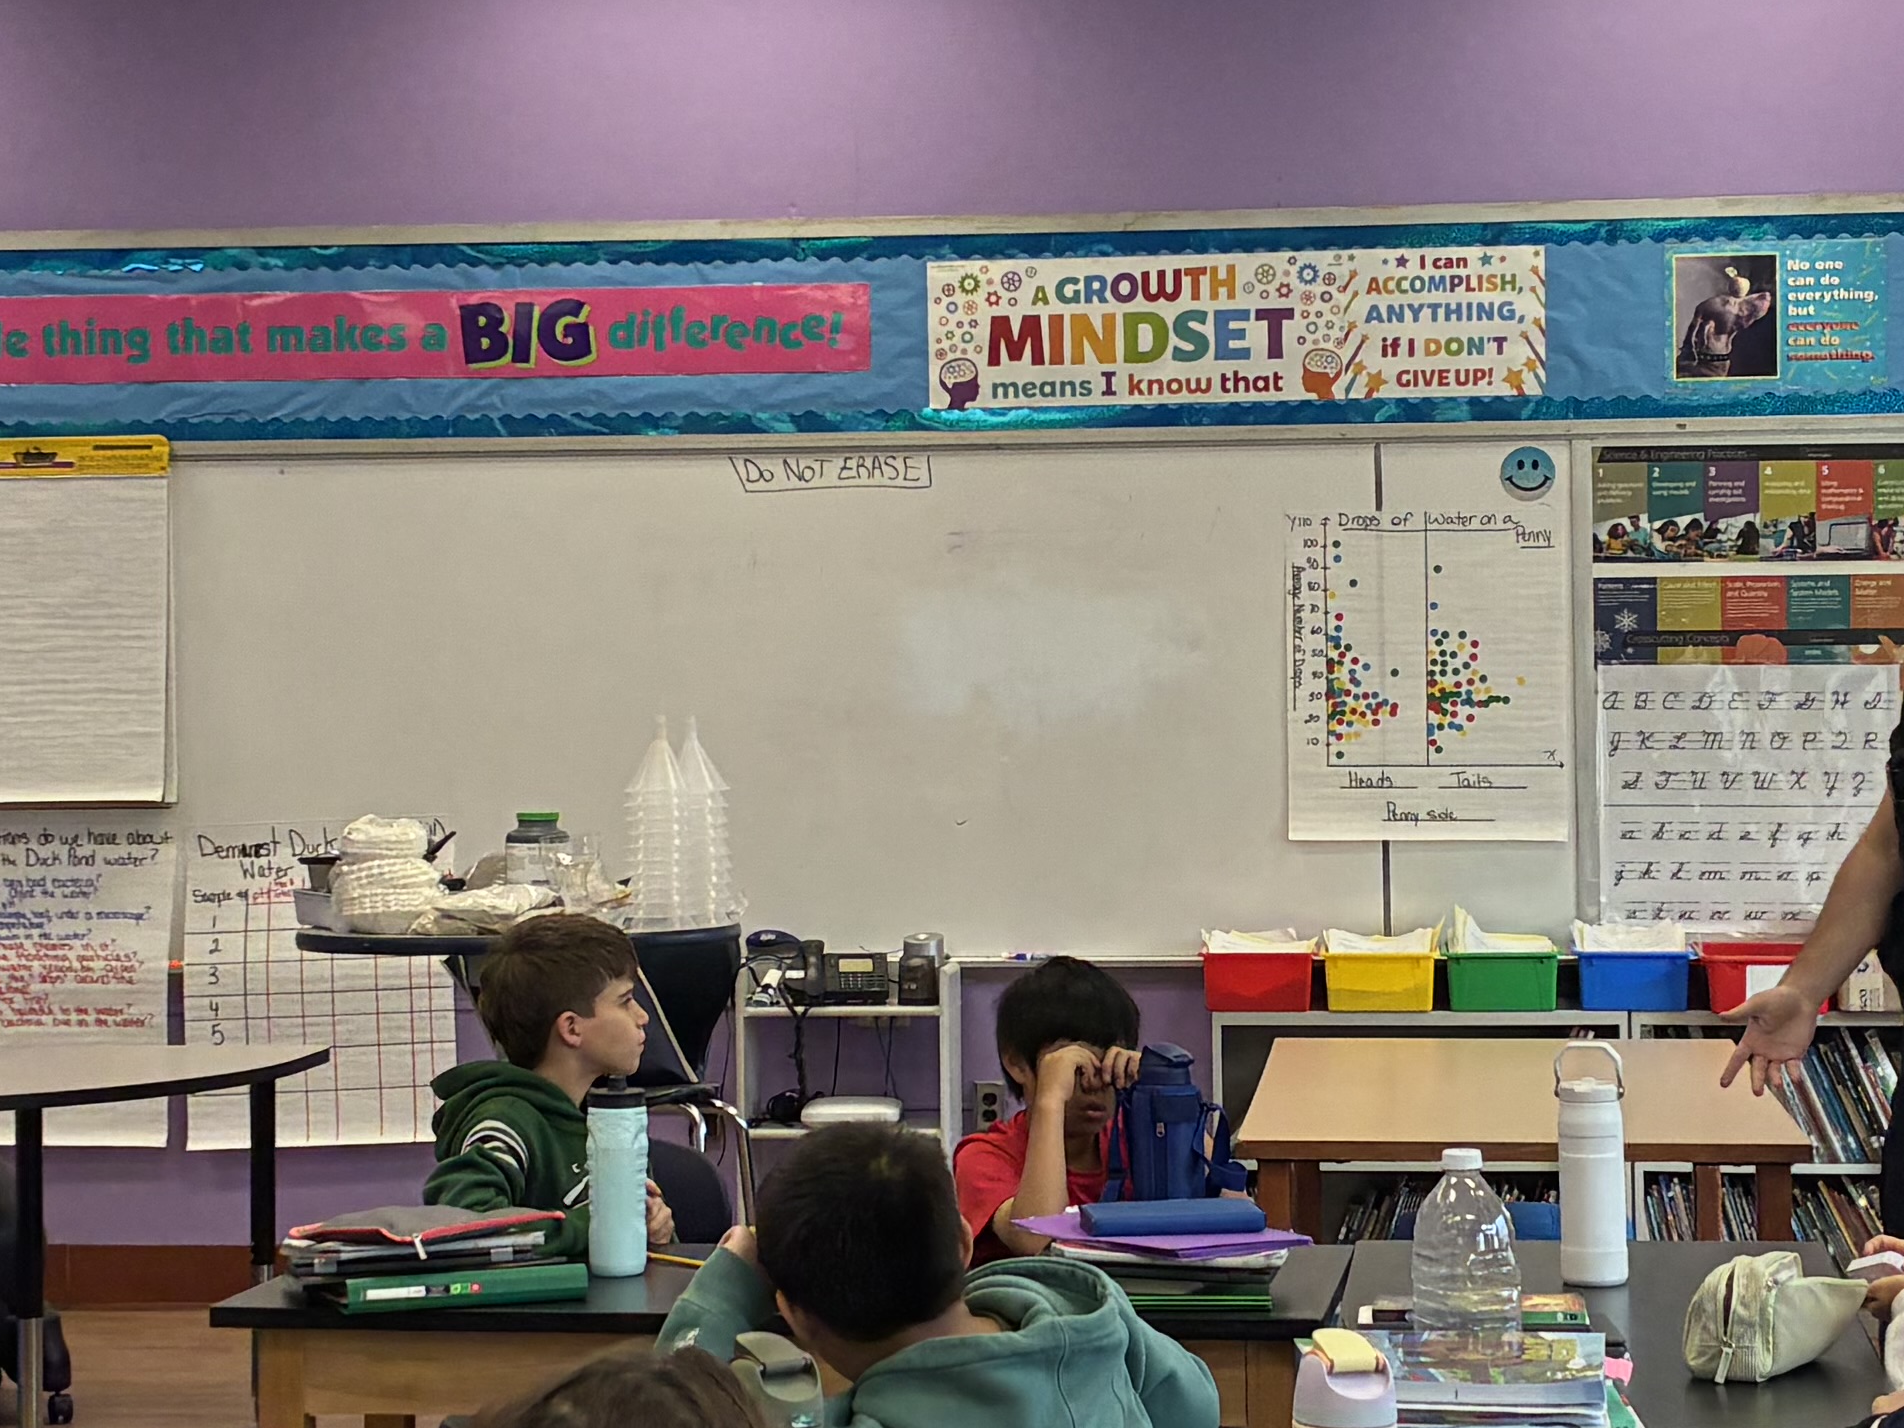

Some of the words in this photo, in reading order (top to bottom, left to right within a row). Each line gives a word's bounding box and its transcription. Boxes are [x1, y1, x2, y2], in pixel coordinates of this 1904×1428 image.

[1419, 255, 1426, 270] I
[1429, 256, 1468, 269] can
[1787, 259, 1810, 271] No
[1815, 260, 1844, 270] one
[1031, 286, 1049, 305] A
[1055, 265, 1236, 304] GROWTH
[1787, 276, 1815, 286] can
[1820, 273, 1840, 285] do
[1787, 288, 1879, 303] everything,
[1788, 304, 1815, 316] but
[43, 319, 151, 363] thing
[166, 317, 252, 355] that
[267, 315, 406, 353] makes
[420, 323, 447, 350] a
[459, 298, 596, 369] BIG
[608, 308, 842, 353] difference!
[988, 308, 1294, 367] MINDSET
[1787, 335, 1815, 346] can
[1820, 332, 1840, 346] do
[1381, 335, 1400, 358] if
[1406, 337, 1415, 356] I
[1423, 335, 1507, 357] DON'T
[992, 378, 1093, 398] means
[1101, 372, 1117, 396] I
[1128, 372, 1212, 396] know
[1220, 371, 1283, 393] that
[1396, 367, 1453, 388] GIVE
[1455, 366, 1494, 386] UP!
[1603, 449, 1639, 461] Science
[1651, 449, 1705, 462] Engineering
[838, 456, 921, 481] ERASE
[1653, 467, 1660, 477] 2
[1709, 467, 1716, 476] 3
[1764, 466, 1773, 476] 4
[1822, 465, 1829, 476] 5
[1339, 513, 1380, 527] Drops
[1391, 512, 1413, 526] of
[1428, 512, 1474, 526] Water
[1480, 513, 1497, 525] on
[1503, 515, 1520, 525] a
[1303, 538, 1318, 549] 100
[1311, 626, 1322, 636] 60
[1306, 738, 1319, 746] 10
[1348, 770, 1393, 787] Heads
[1449, 771, 1493, 787] Tails
[1386, 802, 1419, 827] Penny
[1426, 808, 1458, 821] side
[37, 827, 55, 846] do
[60, 836, 83, 847] we
[88, 828, 120, 846] have
[127, 829, 174, 846] about
[289, 827, 338, 856] Duck
[1, 851, 17, 866] the
[25, 848, 63, 867] Duck
[67, 847, 95, 867] Pond
[104, 848, 158, 867] water?
[240, 861, 294, 880] Water
[192, 890, 233, 909] Sample
[211, 916, 217, 928] 1
[209, 938, 222, 954] 2
[208, 966, 219, 985] 3
[210, 1000, 219, 1017] 4
[212, 1024, 225, 1045] 5
